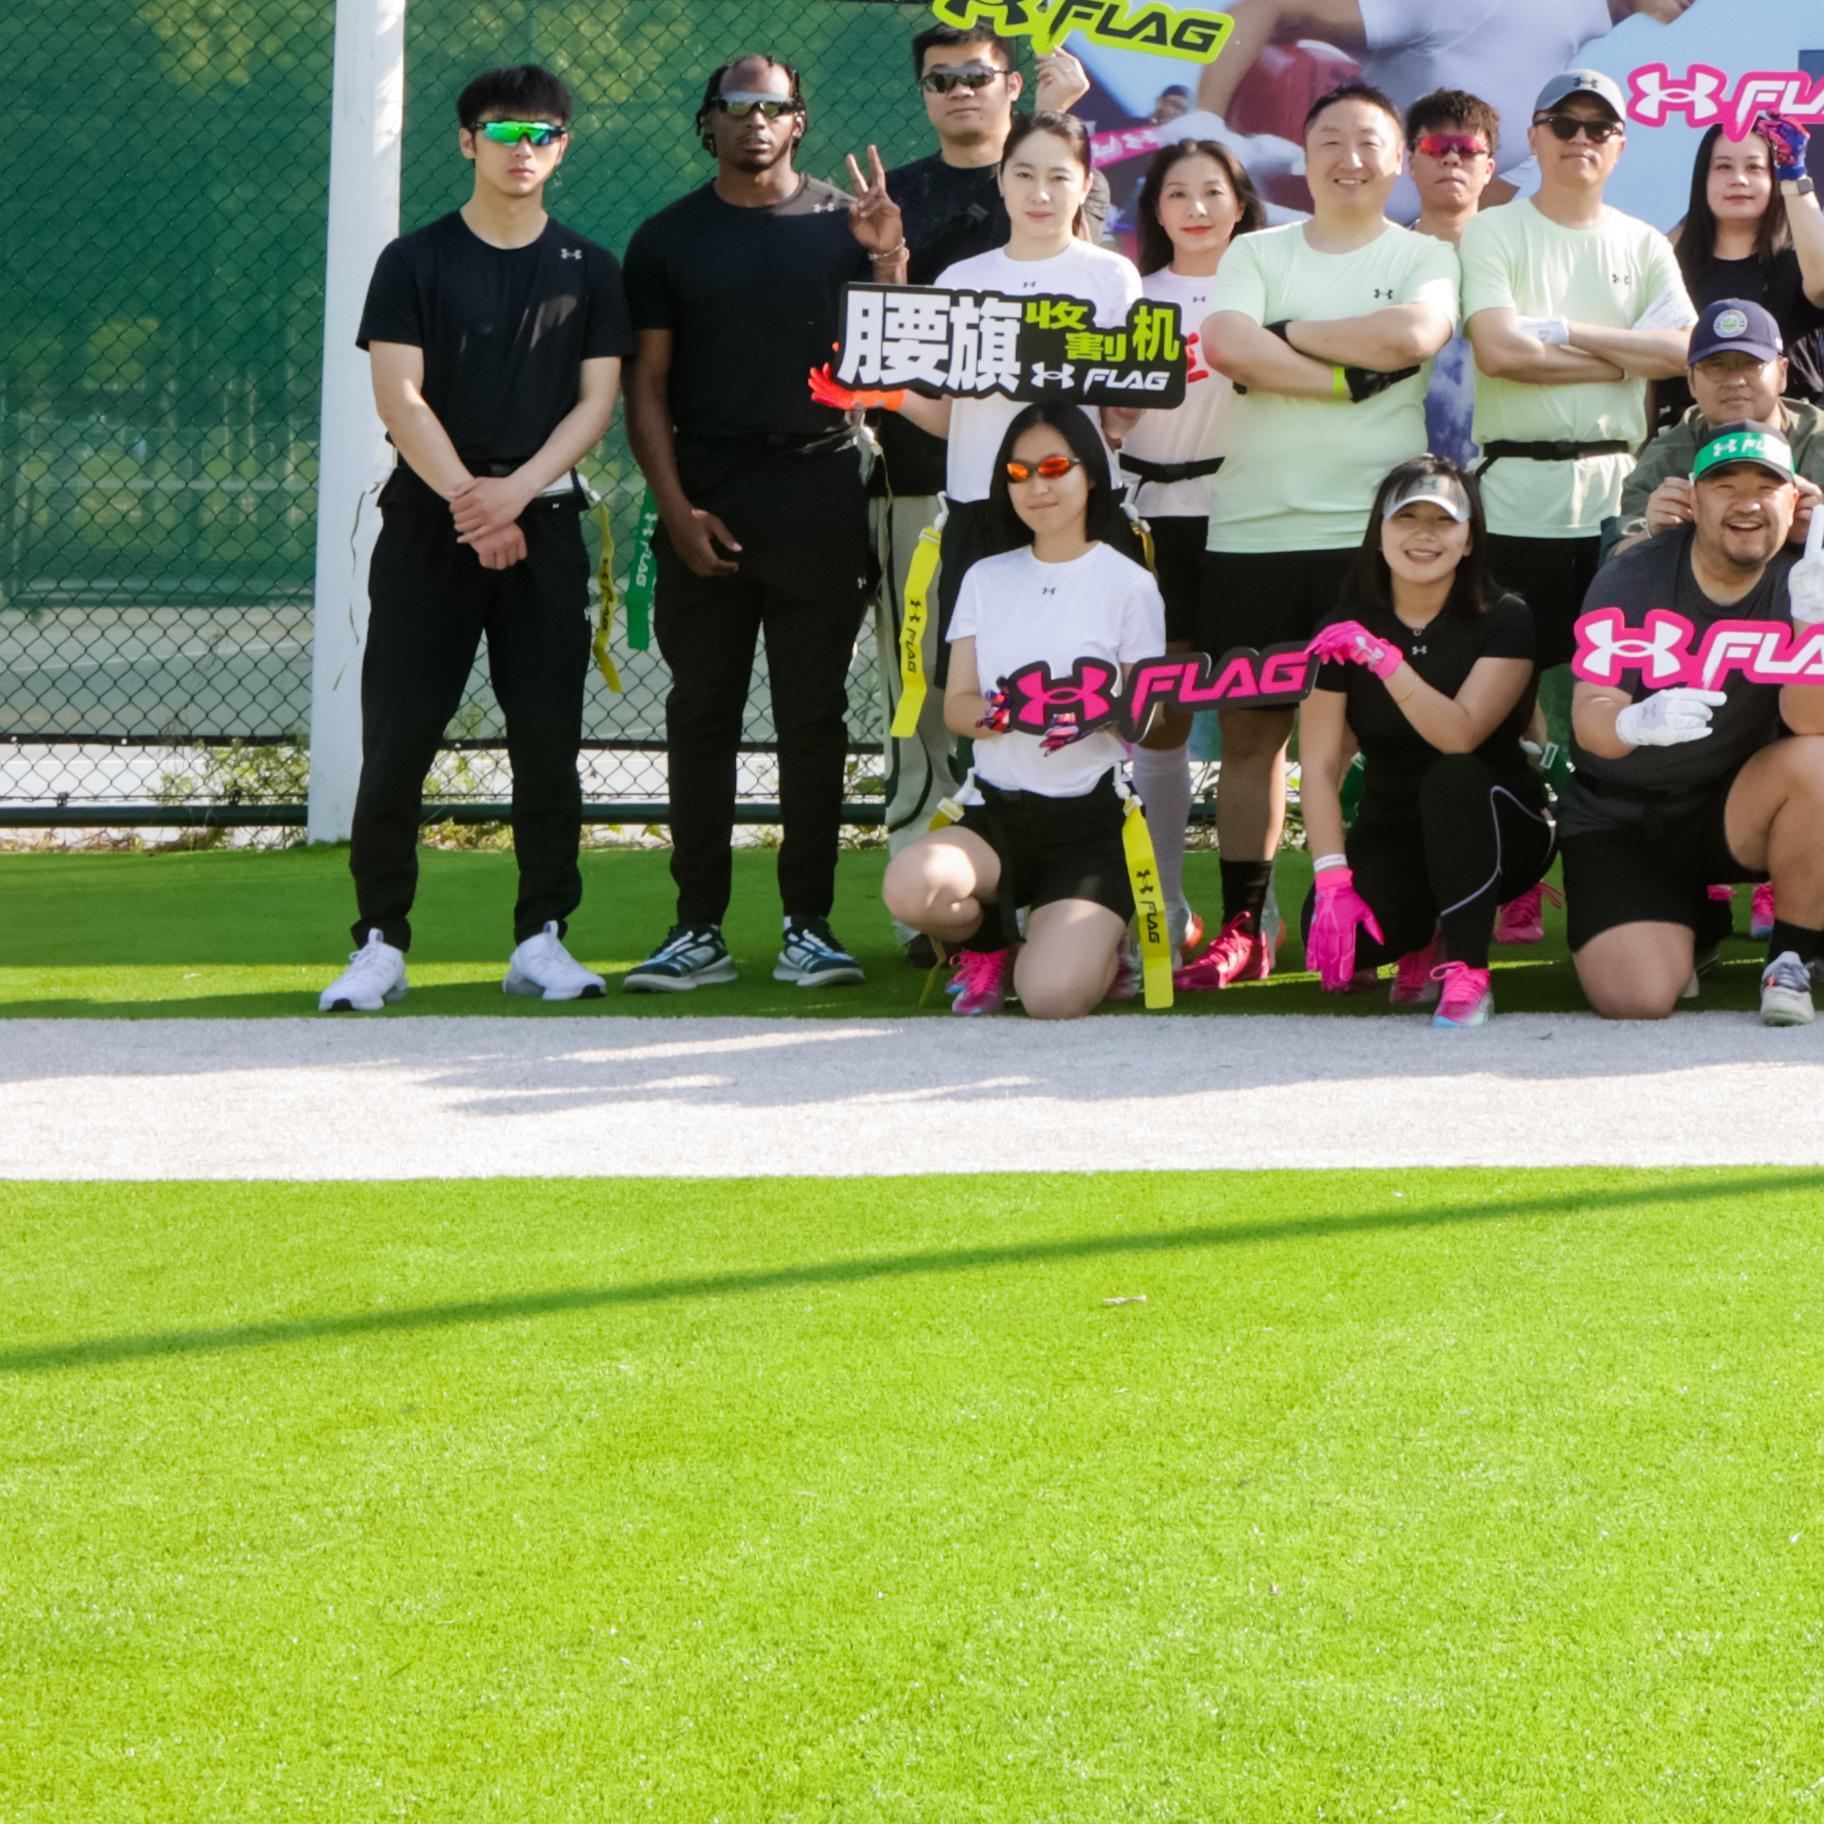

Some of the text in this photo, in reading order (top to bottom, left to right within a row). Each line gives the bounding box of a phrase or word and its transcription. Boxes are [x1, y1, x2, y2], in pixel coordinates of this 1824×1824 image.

[838, 290, 1181, 394] 腰旗收割机
[1083, 368, 1171, 394] FLAG
[905, 627, 917, 674] FLAG
[1130, 649, 1309, 723] FLAG
[1140, 900, 1160, 944] FLAG
